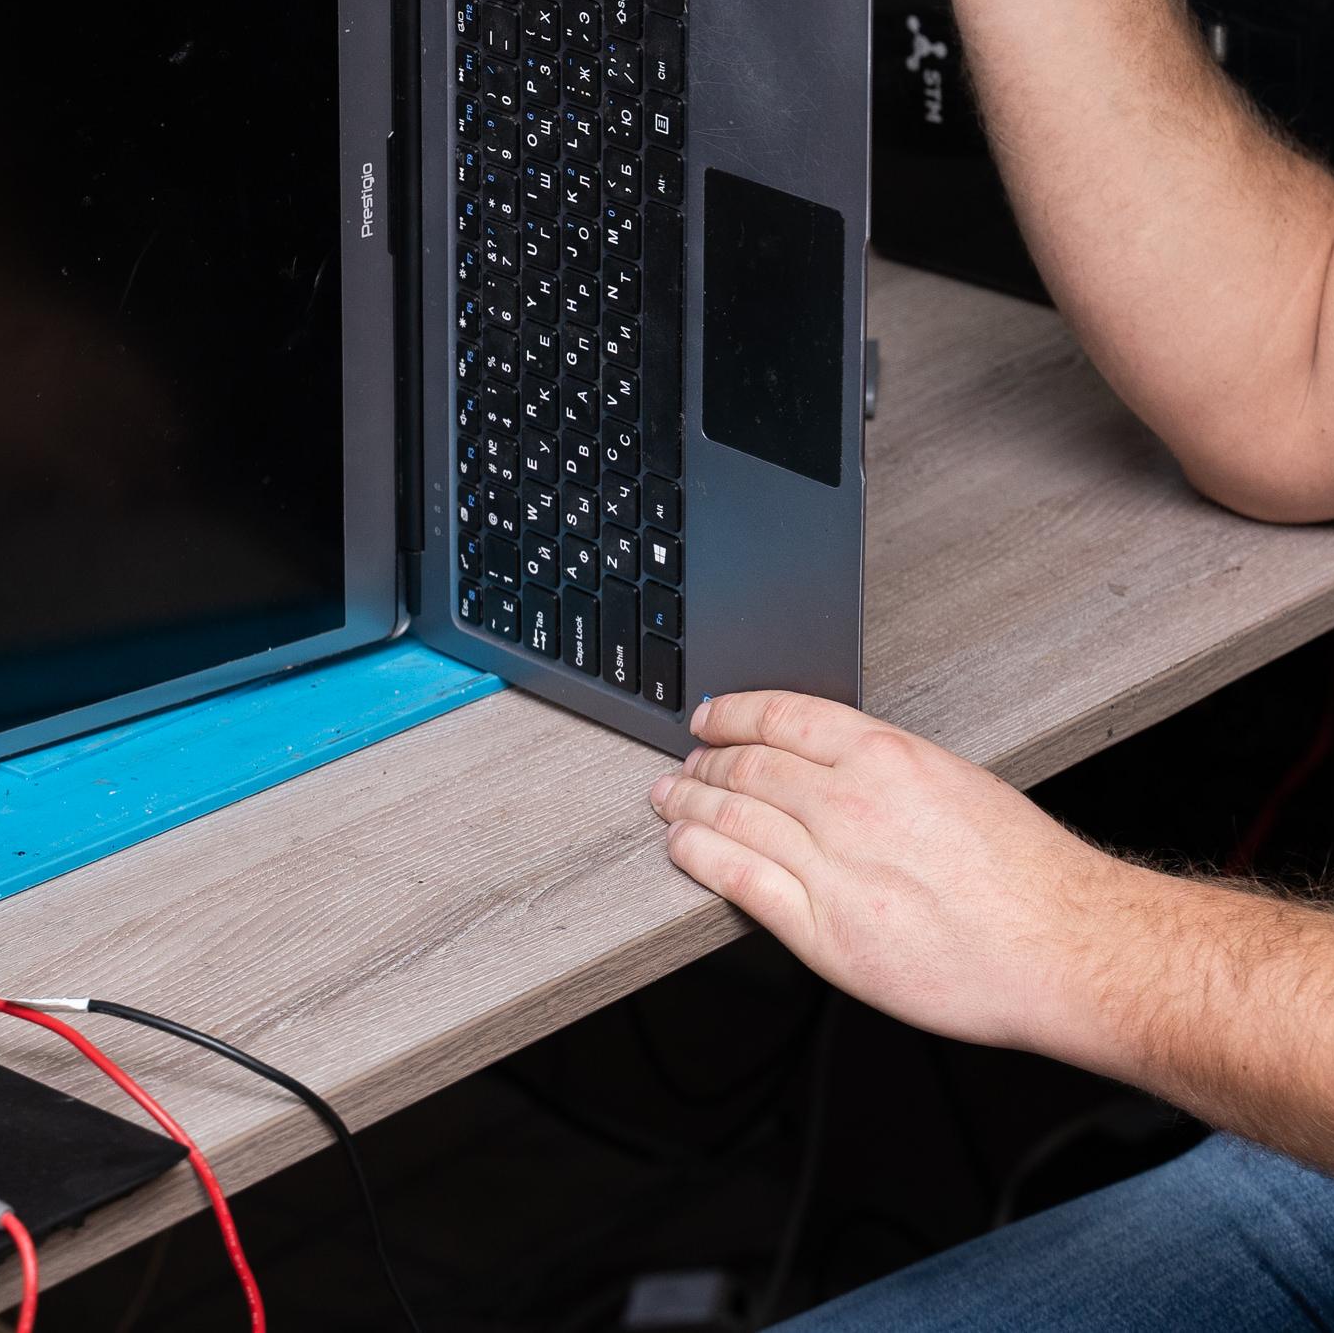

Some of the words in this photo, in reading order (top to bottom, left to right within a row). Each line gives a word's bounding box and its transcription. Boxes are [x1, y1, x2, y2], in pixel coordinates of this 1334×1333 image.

[657, 61, 665, 80] Ctrl
[527, 80, 538, 94] P
[527, 134, 538, 148] O
[567, 138, 578, 148] L
[467, 154, 473, 166] F9
[360, 160, 374, 238] Prestigio
[567, 190, 578, 204] K
[467, 204, 473, 216] F8
[607, 229, 619, 245] M
[527, 244, 538, 256] U
[567, 246, 578, 258] J
[467, 252, 473, 265] F7
[607, 285, 619, 300] N
[467, 302, 473, 314] F6
[527, 296, 537, 308] Y
[567, 299, 577, 312] H
[607, 342, 618, 354] B
[467, 351, 473, 362] F5
[527, 350, 537, 362] T
[567, 352, 577, 365] G
[467, 400, 474, 411] F4
[607, 394, 618, 406] V
[527, 404, 537, 418] R
[567, 408, 577, 420] F
[468, 447, 475, 458] F3
[607, 448, 618, 461] C
[527, 458, 538, 470] E
[567, 460, 577, 474] D
[468, 494, 475, 506] F2
[527, 504, 538, 521] W
[607, 502, 619, 516] X
[567, 512, 577, 526] S
[468, 542, 475, 554] F1
[527, 560, 539, 574] Q
[607, 555, 617, 570] Z
[567, 566, 577, 580] A
[461, 599, 469, 617] Esc
[536, 611, 544, 629] Tab
[656, 613, 664, 626] Fn
[575, 616, 583, 640] Lock
[575, 642, 583, 666] Caps
[656, 682, 664, 700] Ctrl
